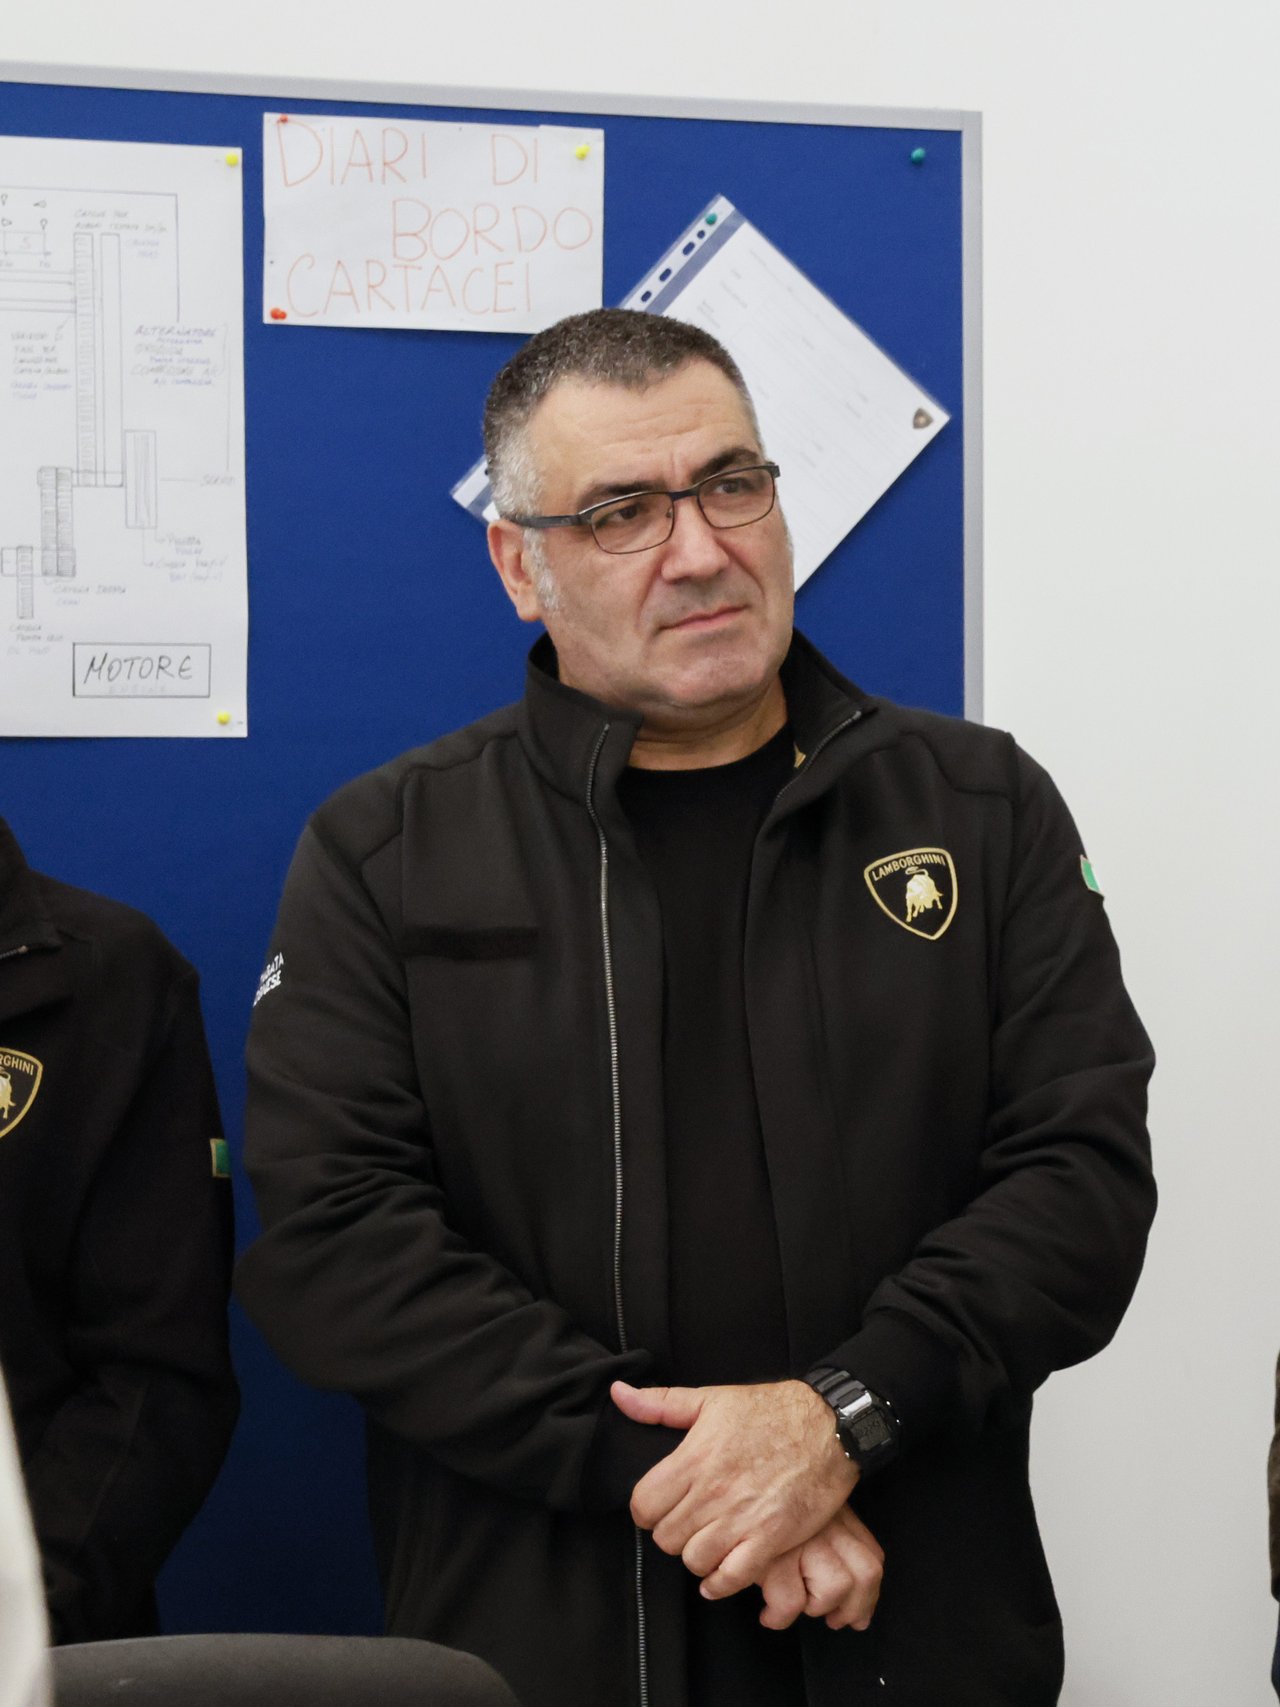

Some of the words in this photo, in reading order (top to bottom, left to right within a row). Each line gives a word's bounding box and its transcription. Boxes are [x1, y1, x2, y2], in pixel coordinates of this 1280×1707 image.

[276, 119, 427, 187] DIARI
[490, 133, 539, 186] DI
[392, 198, 593, 262] BORDO
[286, 253, 532, 318] CARTACEI
[83, 652, 194, 684] MOTORE
[871, 853, 947, 881] LAMBORGHINI
